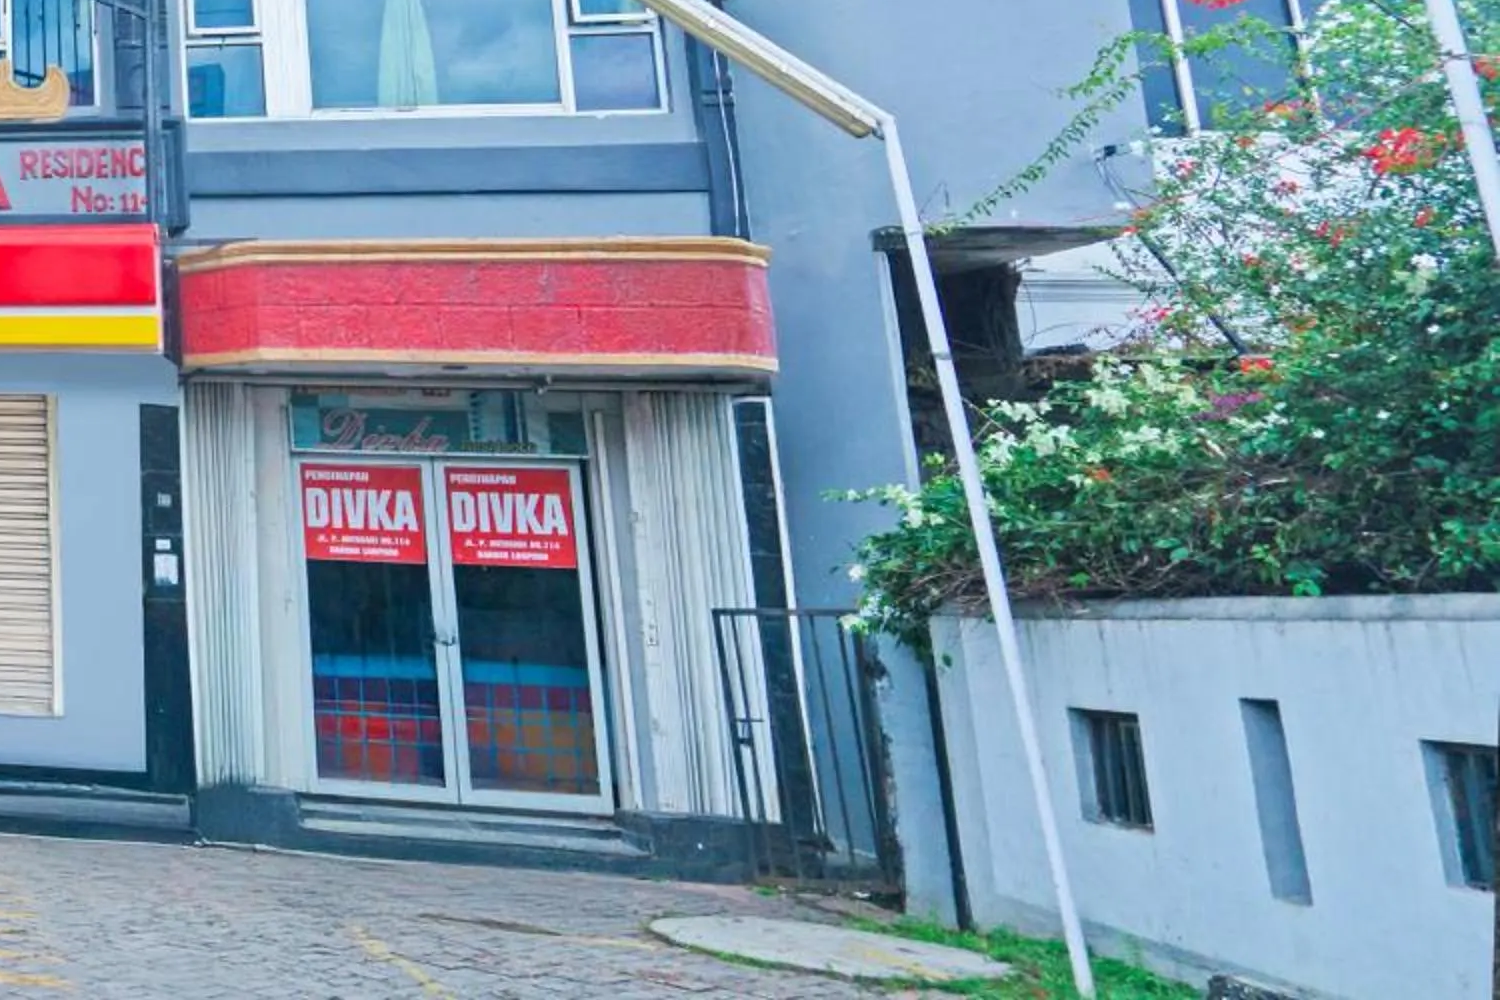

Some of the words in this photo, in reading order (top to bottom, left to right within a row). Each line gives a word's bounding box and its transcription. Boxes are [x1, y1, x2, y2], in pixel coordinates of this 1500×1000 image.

[19, 147, 146, 181] RESIDENC
[120, 192, 148, 213] 11
[306, 487, 420, 532] DIVKA
[451, 491, 569, 537] DIVKA
